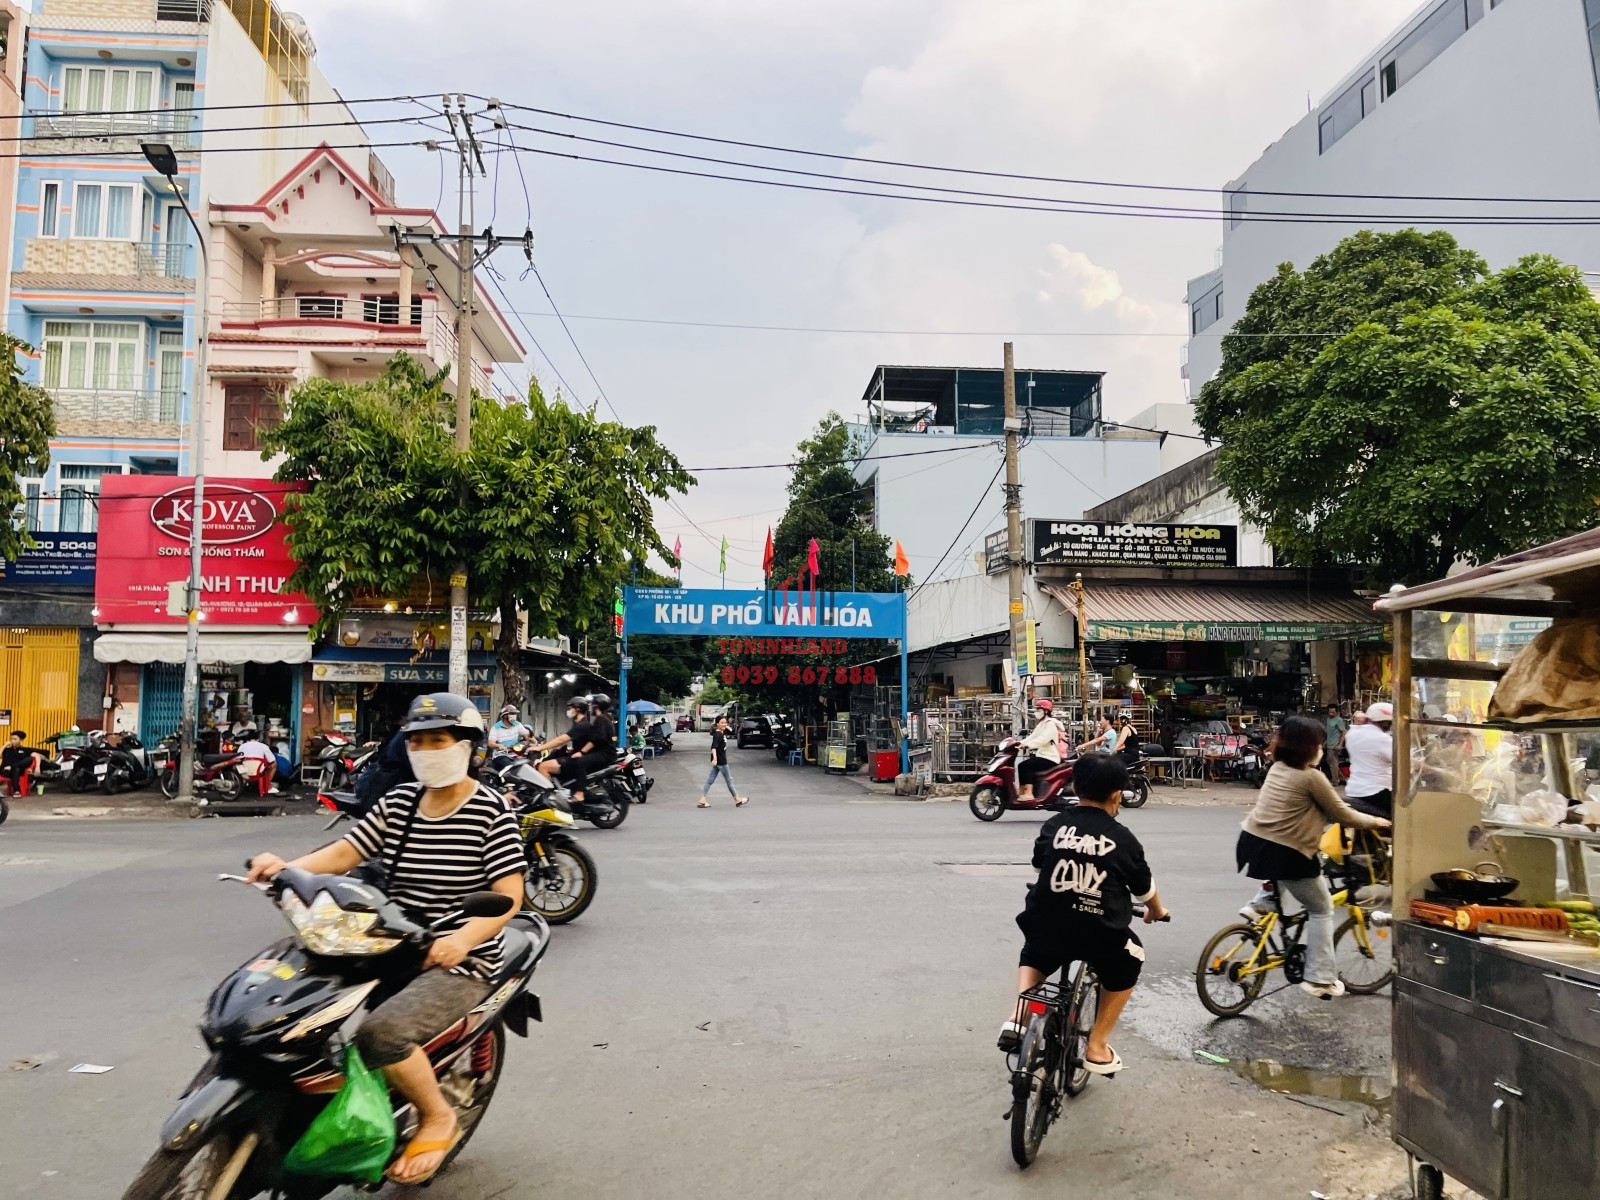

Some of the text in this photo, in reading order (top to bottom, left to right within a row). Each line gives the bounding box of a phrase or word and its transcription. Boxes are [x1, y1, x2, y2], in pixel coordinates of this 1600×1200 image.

[171, 499, 257, 523] KOVA
[202, 523, 235, 531] ROFESSOR
[1050, 522, 1221, 540] HOA HỒNG HÒA
[158, 545, 265, 557] SƠN & HỐNG THẤM
[655, 596, 873, 628] KHU PHỐ VĂN HÓA
[1098, 626, 1131, 640] MUA
[1228, 626, 1250, 641] THANH
[425, 670, 444, 680] XE
